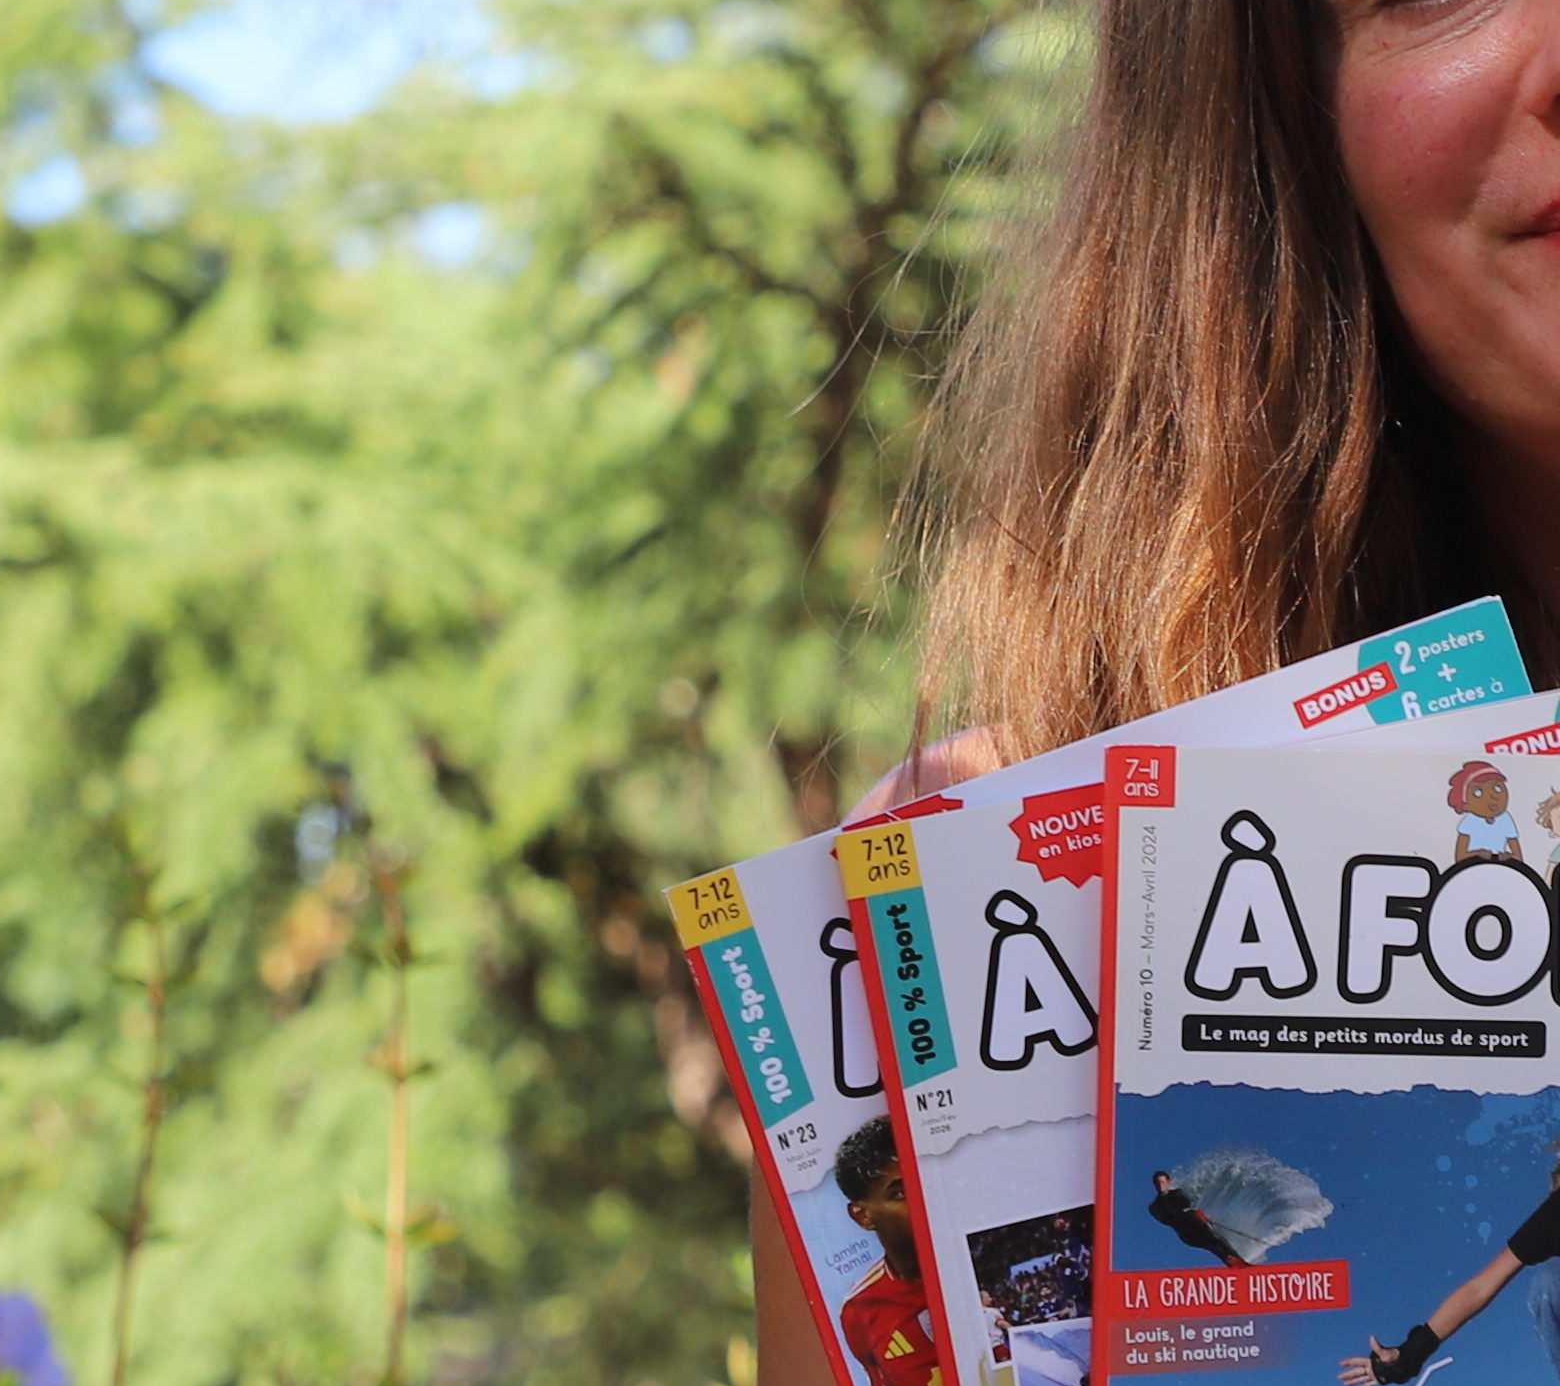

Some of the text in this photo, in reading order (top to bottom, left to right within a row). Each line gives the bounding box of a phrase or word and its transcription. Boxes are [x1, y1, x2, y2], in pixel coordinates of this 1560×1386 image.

[1394, 629, 1485, 675] 2 posters
[1301, 671, 1387, 721] BONUS
[1400, 677, 1505, 720] 6 cartes à
[1125, 758, 1159, 780] 7-11
[1124, 780, 1160, 798] ans
[862, 833, 908, 861] 7-12
[1038, 842, 1062, 859] en
[1142, 825, 1157, 865] 2024
[868, 859, 910, 882] ans
[687, 877, 734, 910] 7-12
[1185, 810, 1318, 1001] À
[698, 902, 740, 930] ans
[886, 903, 936, 1065] 100 % Sport
[981, 889, 1099, 1071] À
[1140, 968, 1154, 987] 10
[721, 945, 793, 1105] 100 % Sport
[1139, 990, 1153, 1051] Numéro
[1199, 1023, 1529, 1053] Le mag des petits mordus de sport
[916, 1089, 954, 1112] N°21
[776, 1123, 817, 1151] N°23
[825, 1238, 869, 1267] Lamine
[835, 1251, 872, 1276] Yamal
[1124, 1271, 1335, 1310] LA GRANDE HISTOIRE
[1125, 1320, 1255, 1348] Louis, le grand
[1125, 1343, 1261, 1369] du ski nautique
